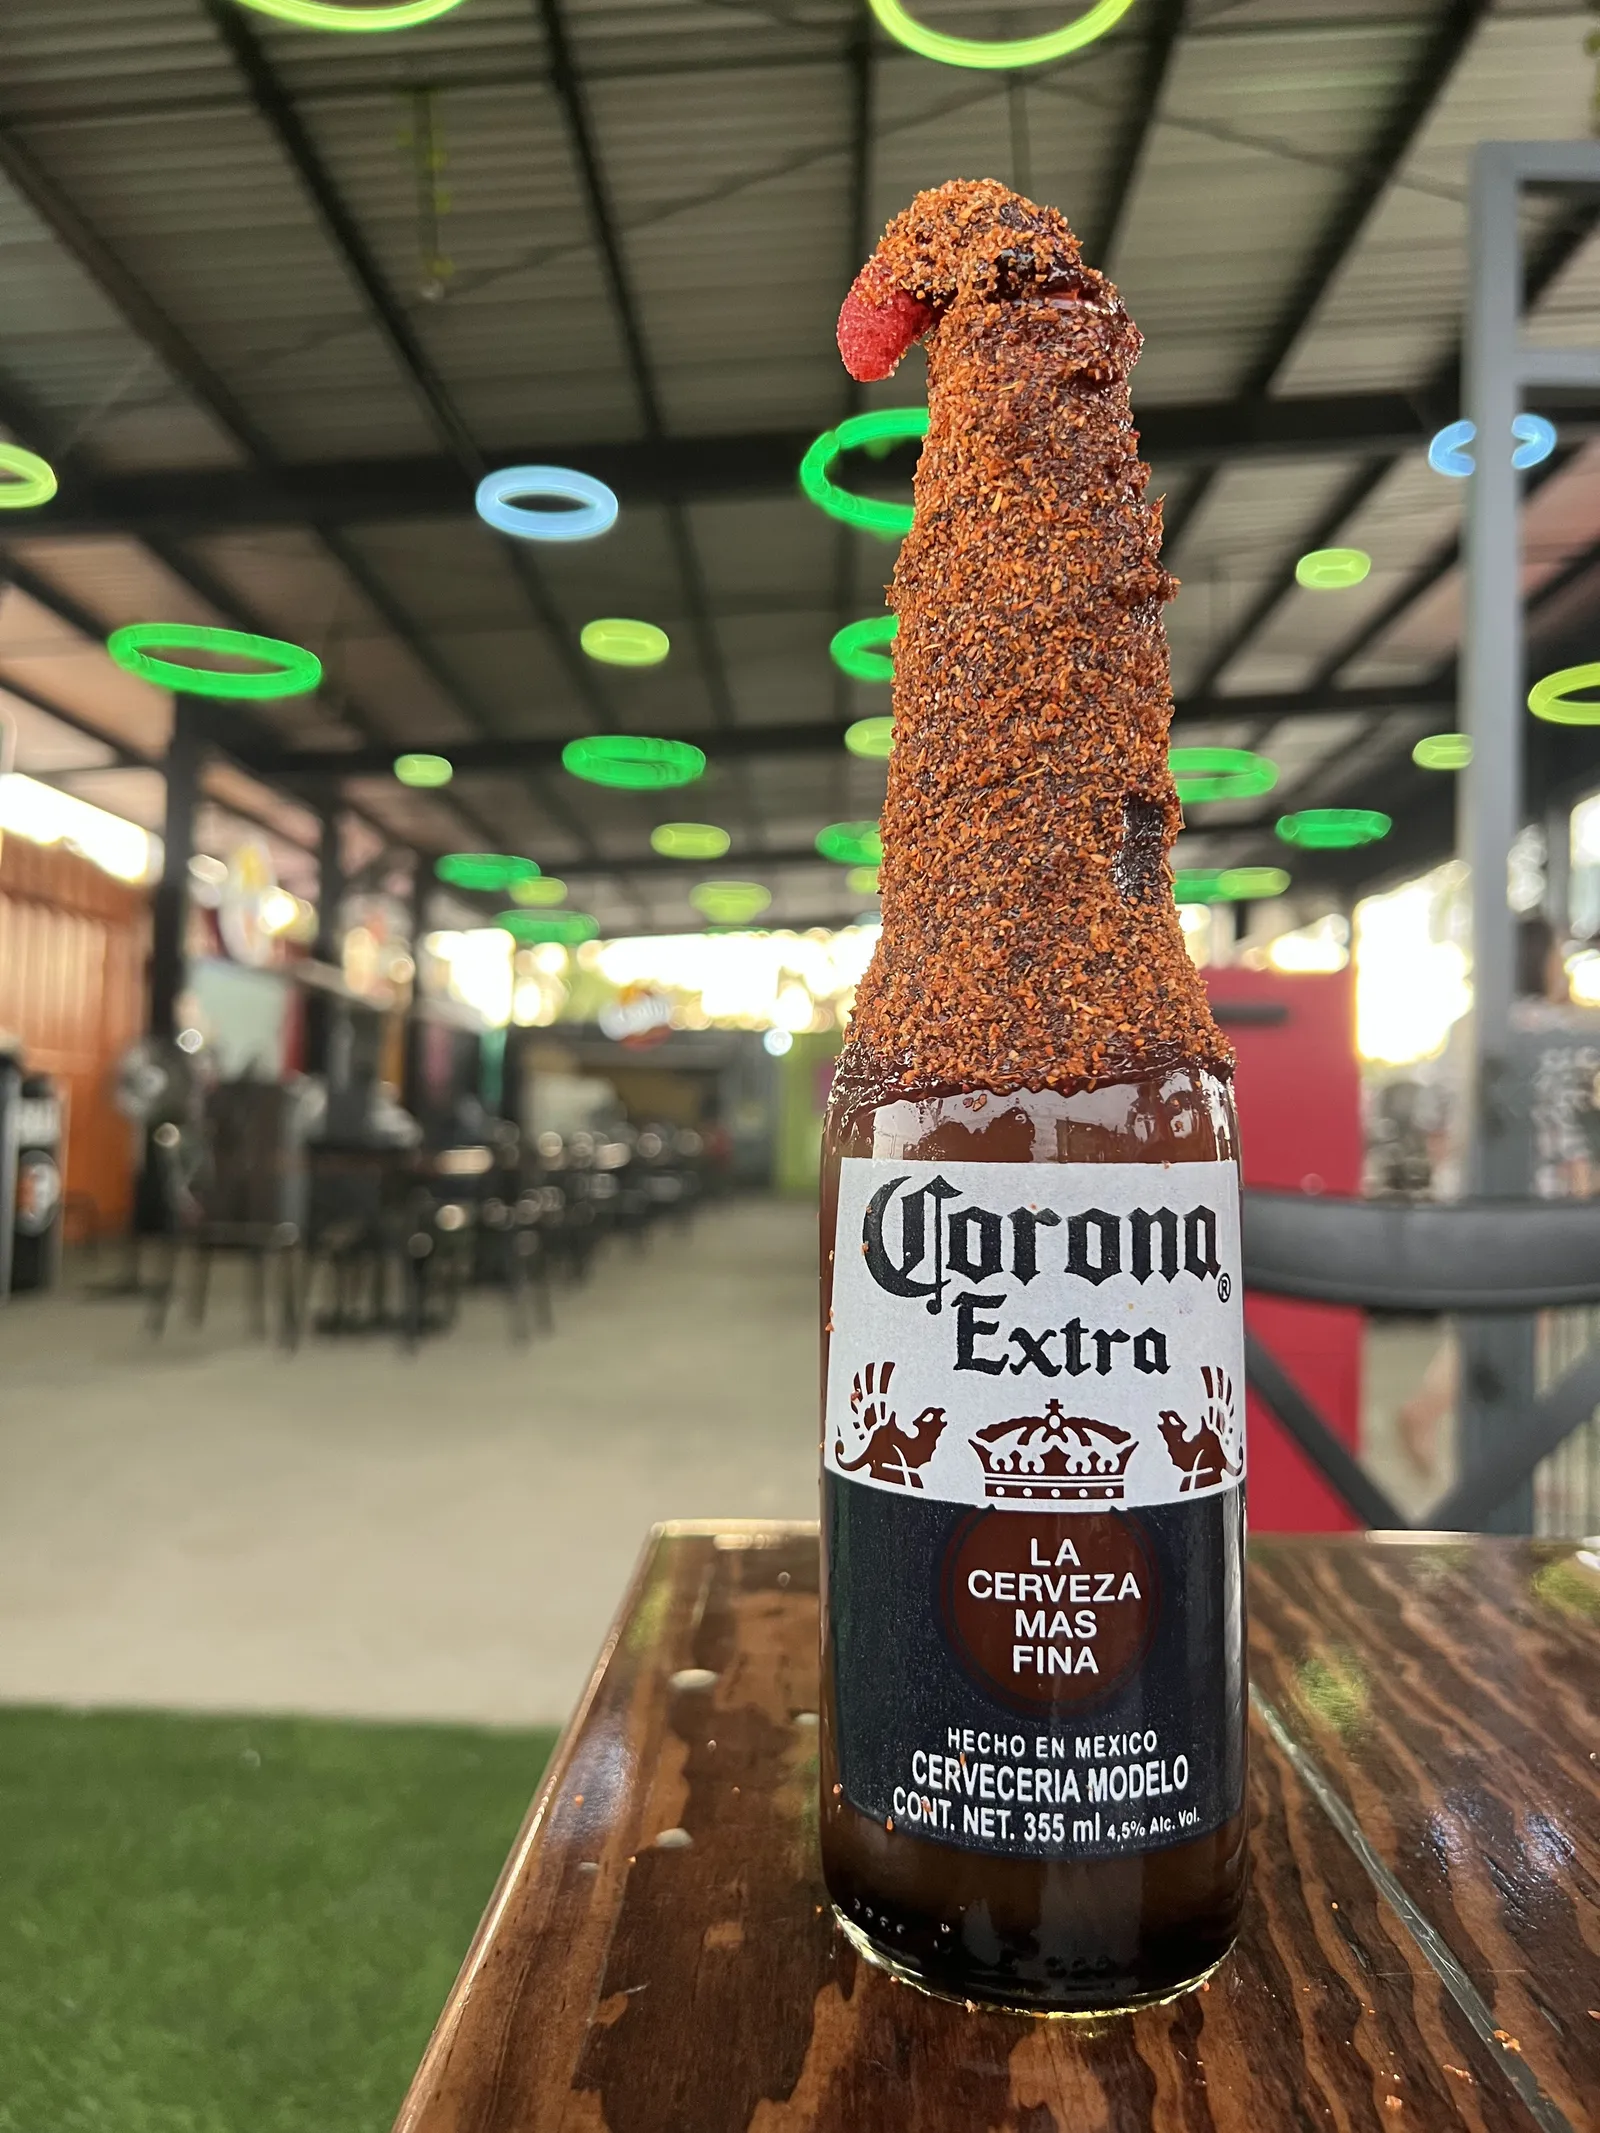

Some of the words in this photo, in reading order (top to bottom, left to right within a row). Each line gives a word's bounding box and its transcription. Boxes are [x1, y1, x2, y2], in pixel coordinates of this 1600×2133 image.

[863, 1175, 1222, 1316] Corona
[950, 1291, 1172, 1377] Extra
[1030, 1537, 1081, 1567] LA
[967, 1569, 1142, 1603] CERVEZA
[1015, 1608, 1097, 1639] MAS
[1012, 1644, 1100, 1675] FINA
[947, 1726, 1026, 1758] HECHO
[1035, 1736, 1065, 1759] EN
[1075, 1729, 1158, 1759] MEXICO
[911, 1749, 1082, 1804] CERVECERIA
[1086, 1754, 1189, 1804] MODELO
[892, 1785, 955, 1831] CONT.
[963, 1804, 1015, 1841] NET.
[1023, 1811, 1066, 1843] 355
[1072, 1811, 1101, 1843] ml
[1106, 1819, 1147, 1843] 4,5%
[1149, 1815, 1176, 1835] Alc.
[1178, 1806, 1201, 1828] Vol.
